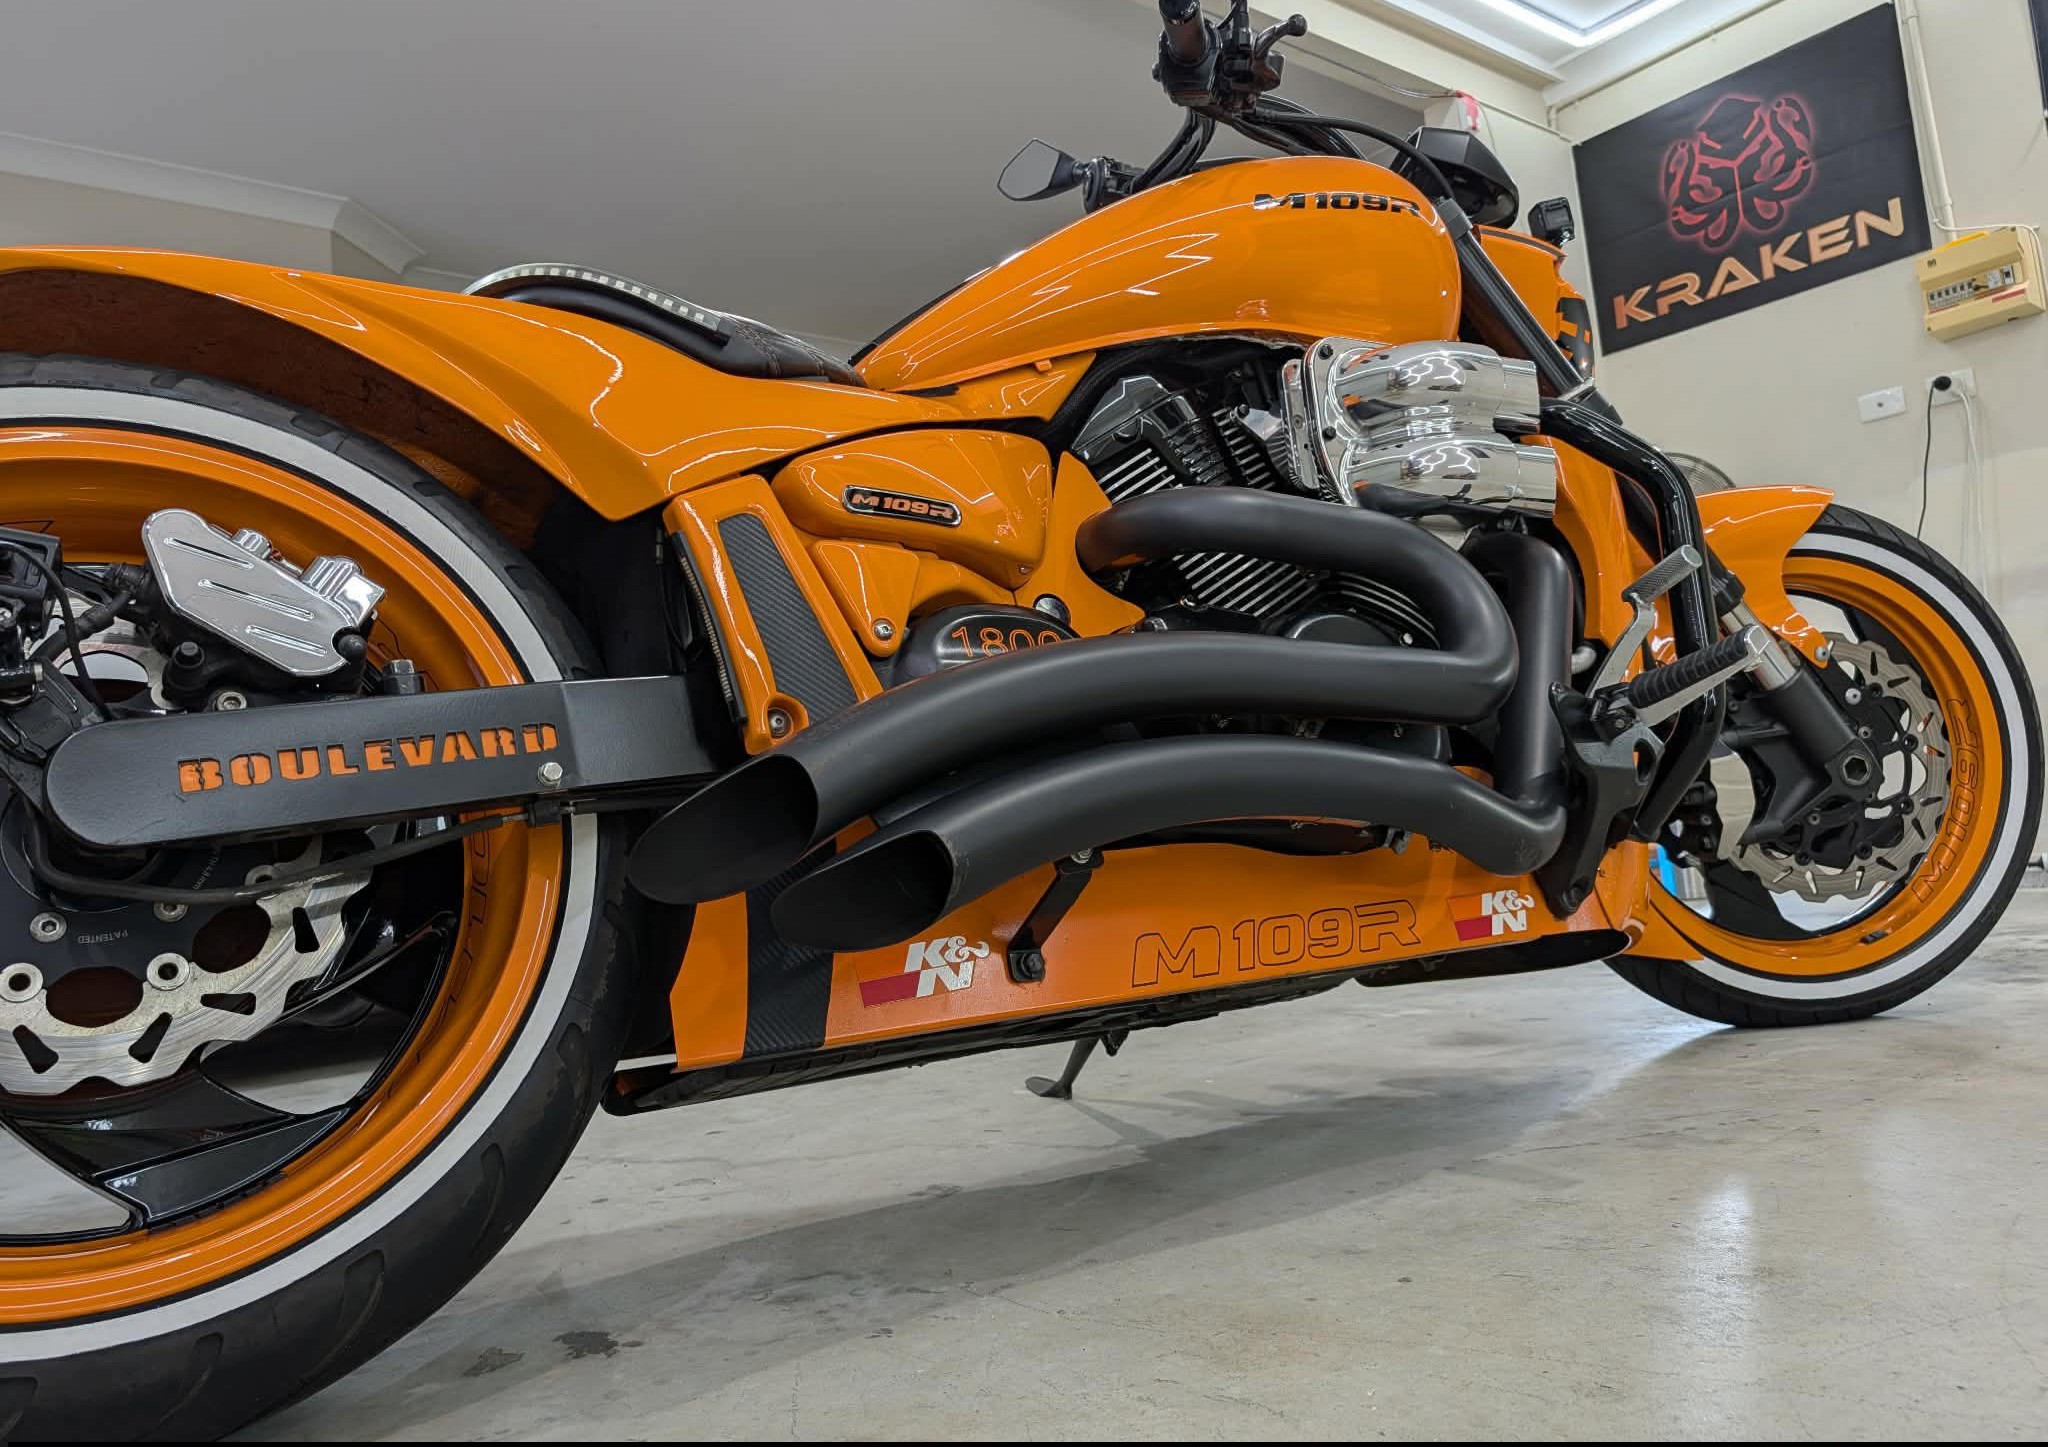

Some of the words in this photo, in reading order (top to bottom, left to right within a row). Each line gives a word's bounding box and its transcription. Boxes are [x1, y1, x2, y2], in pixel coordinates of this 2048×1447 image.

[1612, 196, 1904, 330] KRAKEN
[177, 722, 559, 794] BOULEVARD
[77, 929, 129, 944] PATENTED
